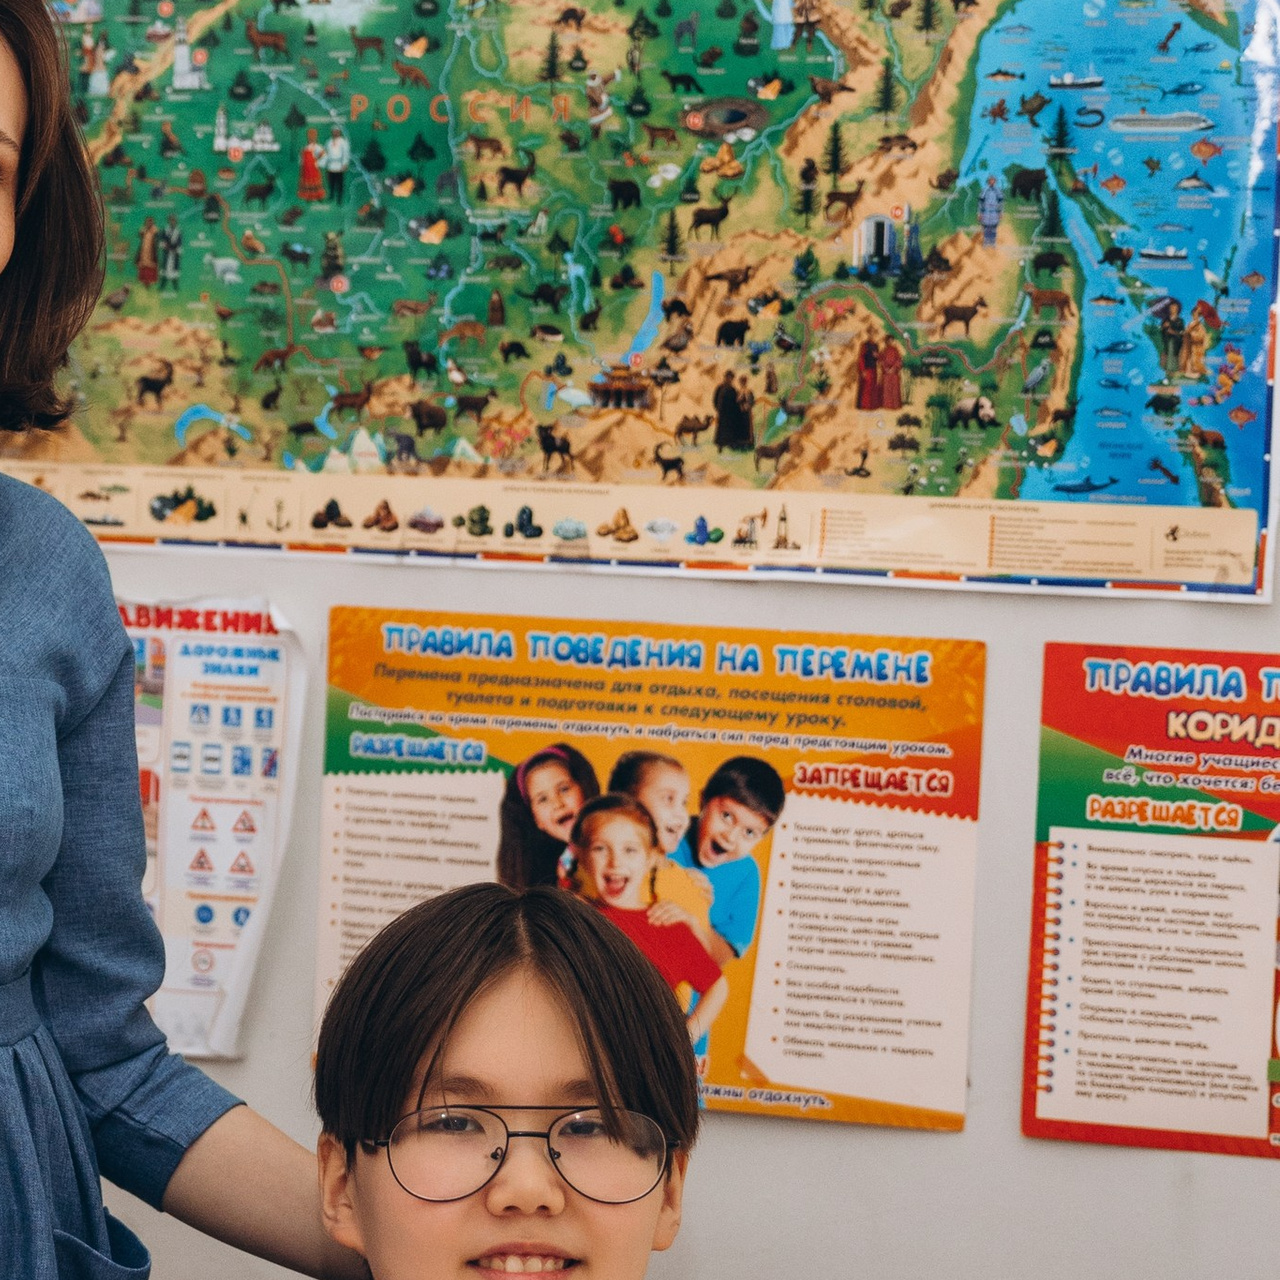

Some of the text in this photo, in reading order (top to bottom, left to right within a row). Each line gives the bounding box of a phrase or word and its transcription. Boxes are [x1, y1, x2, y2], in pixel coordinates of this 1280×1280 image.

[350, 94, 570, 123] РОССИЯ
[383, 624, 932, 685] ПРАВИЛА ПОВЕДЕНИЯ НА ПЕРЕМЕНЕ
[374, 662, 928, 713] Перемена предназначена для отдыха, посещения столовой,
[1085, 660, 1244, 700] ПРАВИЛА
[446, 691, 846, 731] туалета и подготовки к следующему уроку.
[562, 720, 630, 740] отдохнуть
[350, 733, 486, 763] РАЗРЕШАЕТСЯ
[1127, 747, 1195, 764] Многие
[795, 764, 952, 793] ЗАПРЕЩАЕТСЯ
[1105, 768, 1139, 784] всё,
[1144, 773, 1174, 785] что
[1179, 776, 1255, 790] хочется:
[1087, 796, 1242, 828] РАЗРЕШАЕТСЯ
[701, 1086, 832, 1110] лжны отдохнуть.
